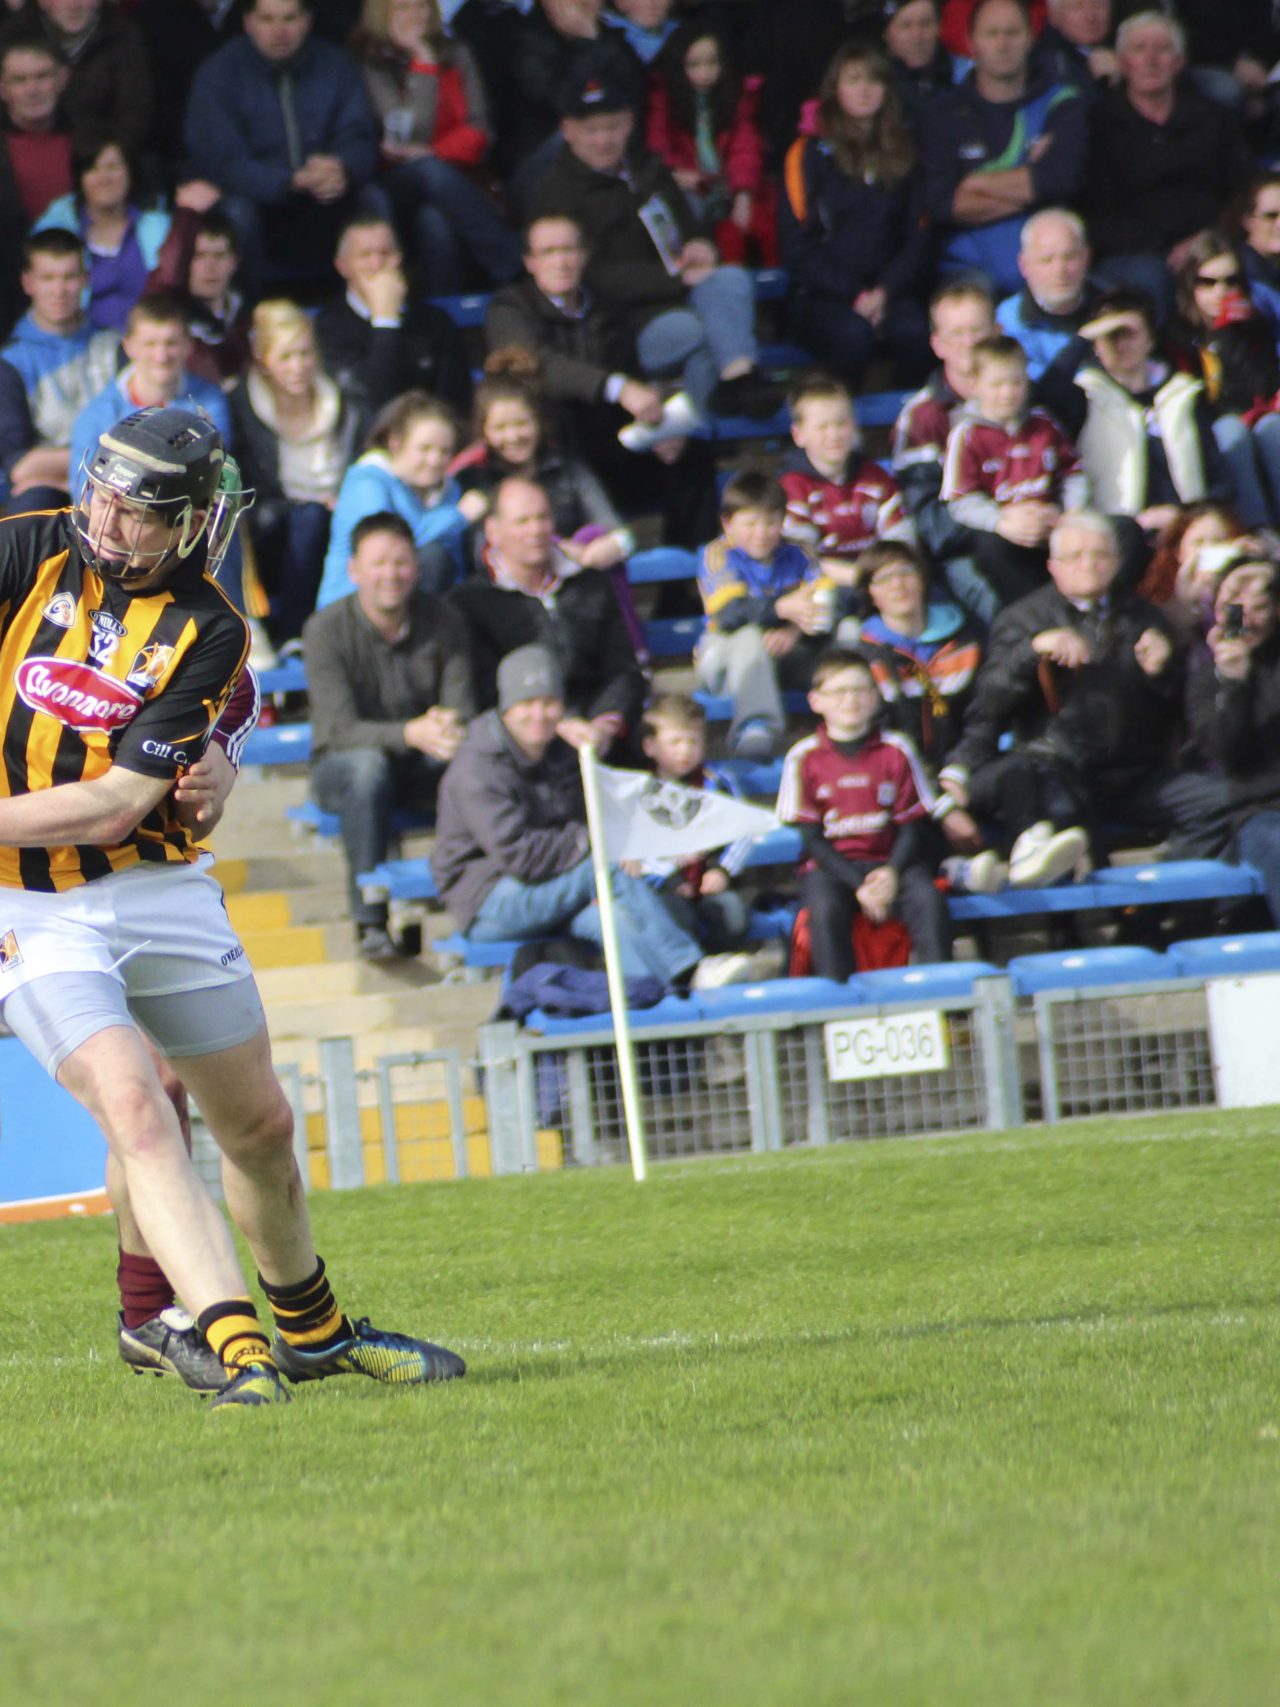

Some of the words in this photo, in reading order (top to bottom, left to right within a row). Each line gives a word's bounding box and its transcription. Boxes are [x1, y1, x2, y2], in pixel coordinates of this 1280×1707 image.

[88, 624, 119, 666] 32
[142, 740, 171, 758] Cill
[833, 1023, 933, 1068] PG-036
